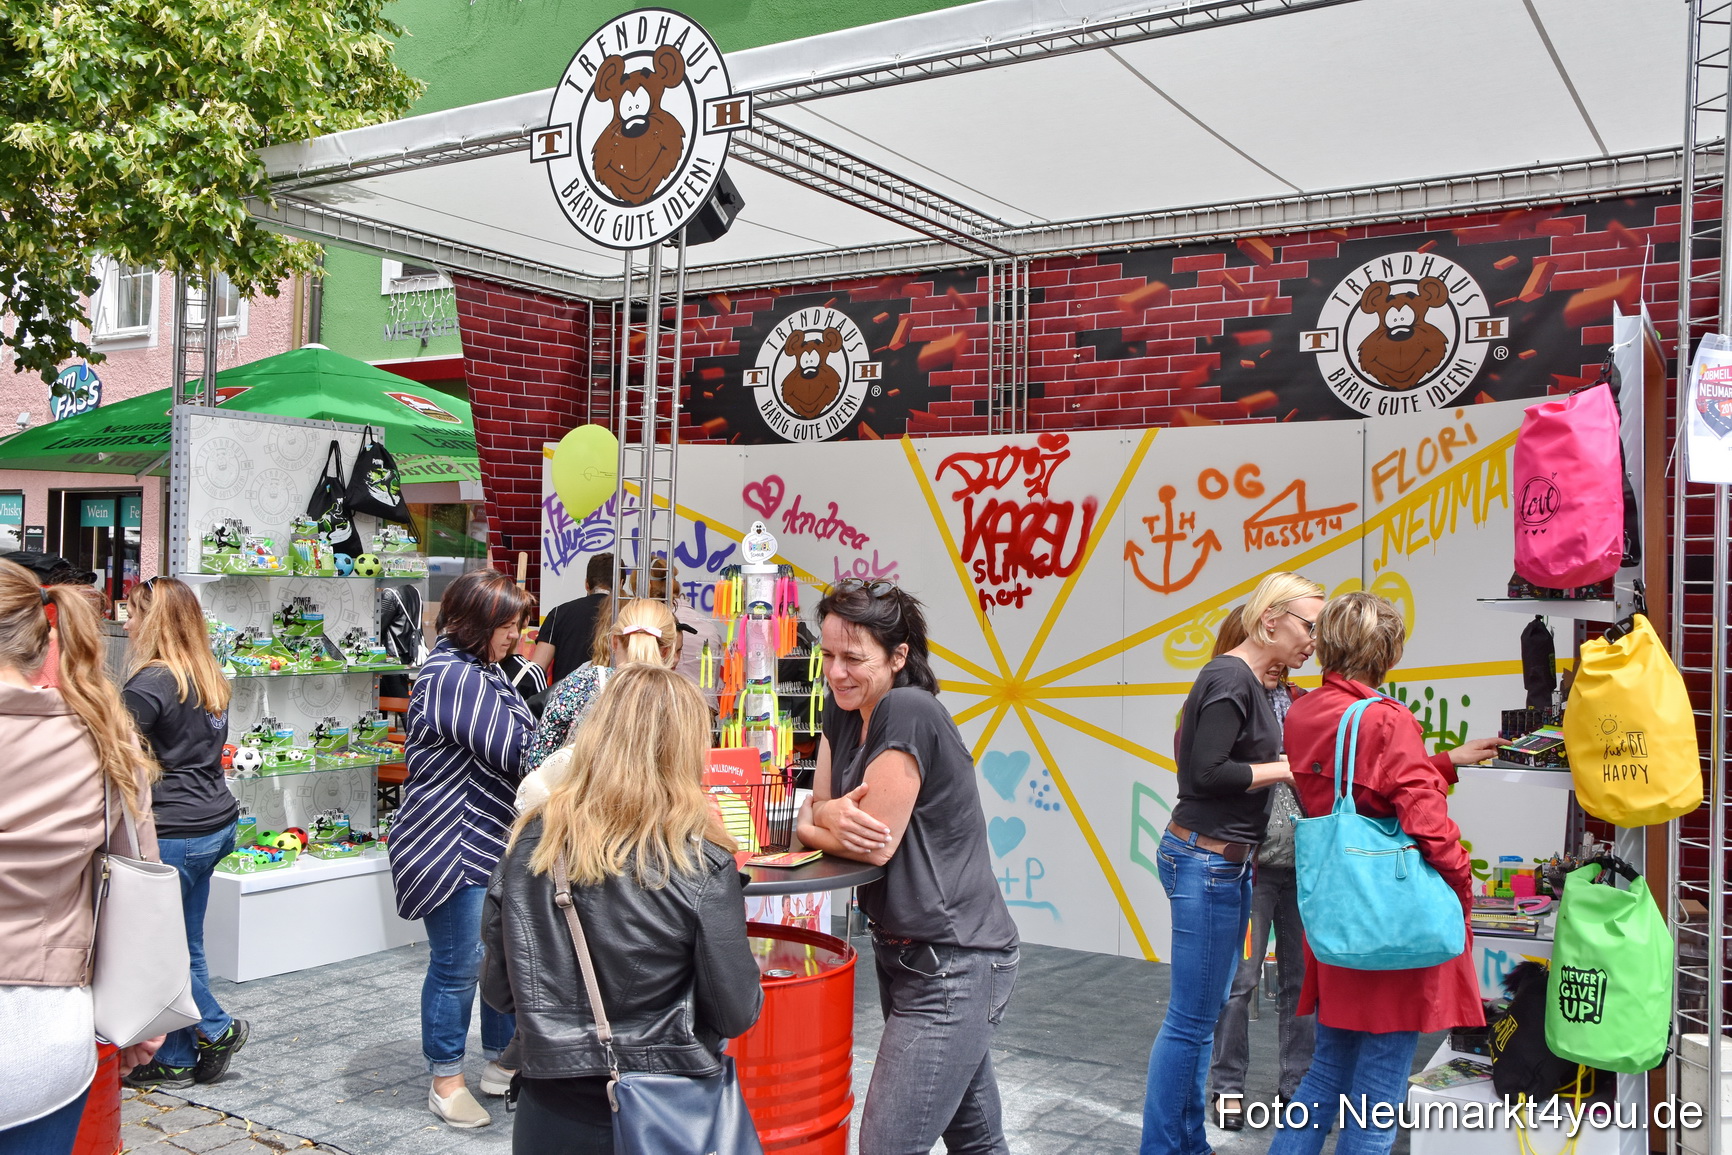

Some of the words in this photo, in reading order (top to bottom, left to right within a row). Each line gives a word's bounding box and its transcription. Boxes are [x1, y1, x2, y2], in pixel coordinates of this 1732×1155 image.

[564, 16, 719, 94] TRENDHAUS
[711, 99, 746, 128] H
[538, 131, 562, 155] T
[561, 177, 608, 234] BÄRIG
[612, 210, 658, 241] GUTE
[662, 157, 716, 226] IDEEN!
[1332, 254, 1480, 307] TRENDHAUS
[765, 308, 864, 353] TRENDHAUS
[1473, 319, 1505, 339] H
[1304, 331, 1330, 350] T
[746, 370, 763, 385] T
[858, 363, 880, 379] H
[1327, 367, 1373, 411] BÄRIG
[1377, 394, 1422, 416] GUTE
[1426, 358, 1478, 408] IDEEN!
[760, 399, 790, 435] BÄRIG
[793, 422, 823, 441] GUTE
[825, 393, 861, 434] IDEEN!
[86, 504, 109, 518] Wein
[293, 596, 311, 606] POWER
[1629, 732, 1648, 757] BE
[709, 763, 744, 777] WILLKOMMEN
[1602, 763, 1649, 785] HAPPY
[1561, 970, 1597, 985] NEVER
[1560, 983, 1597, 1002] GIVE
